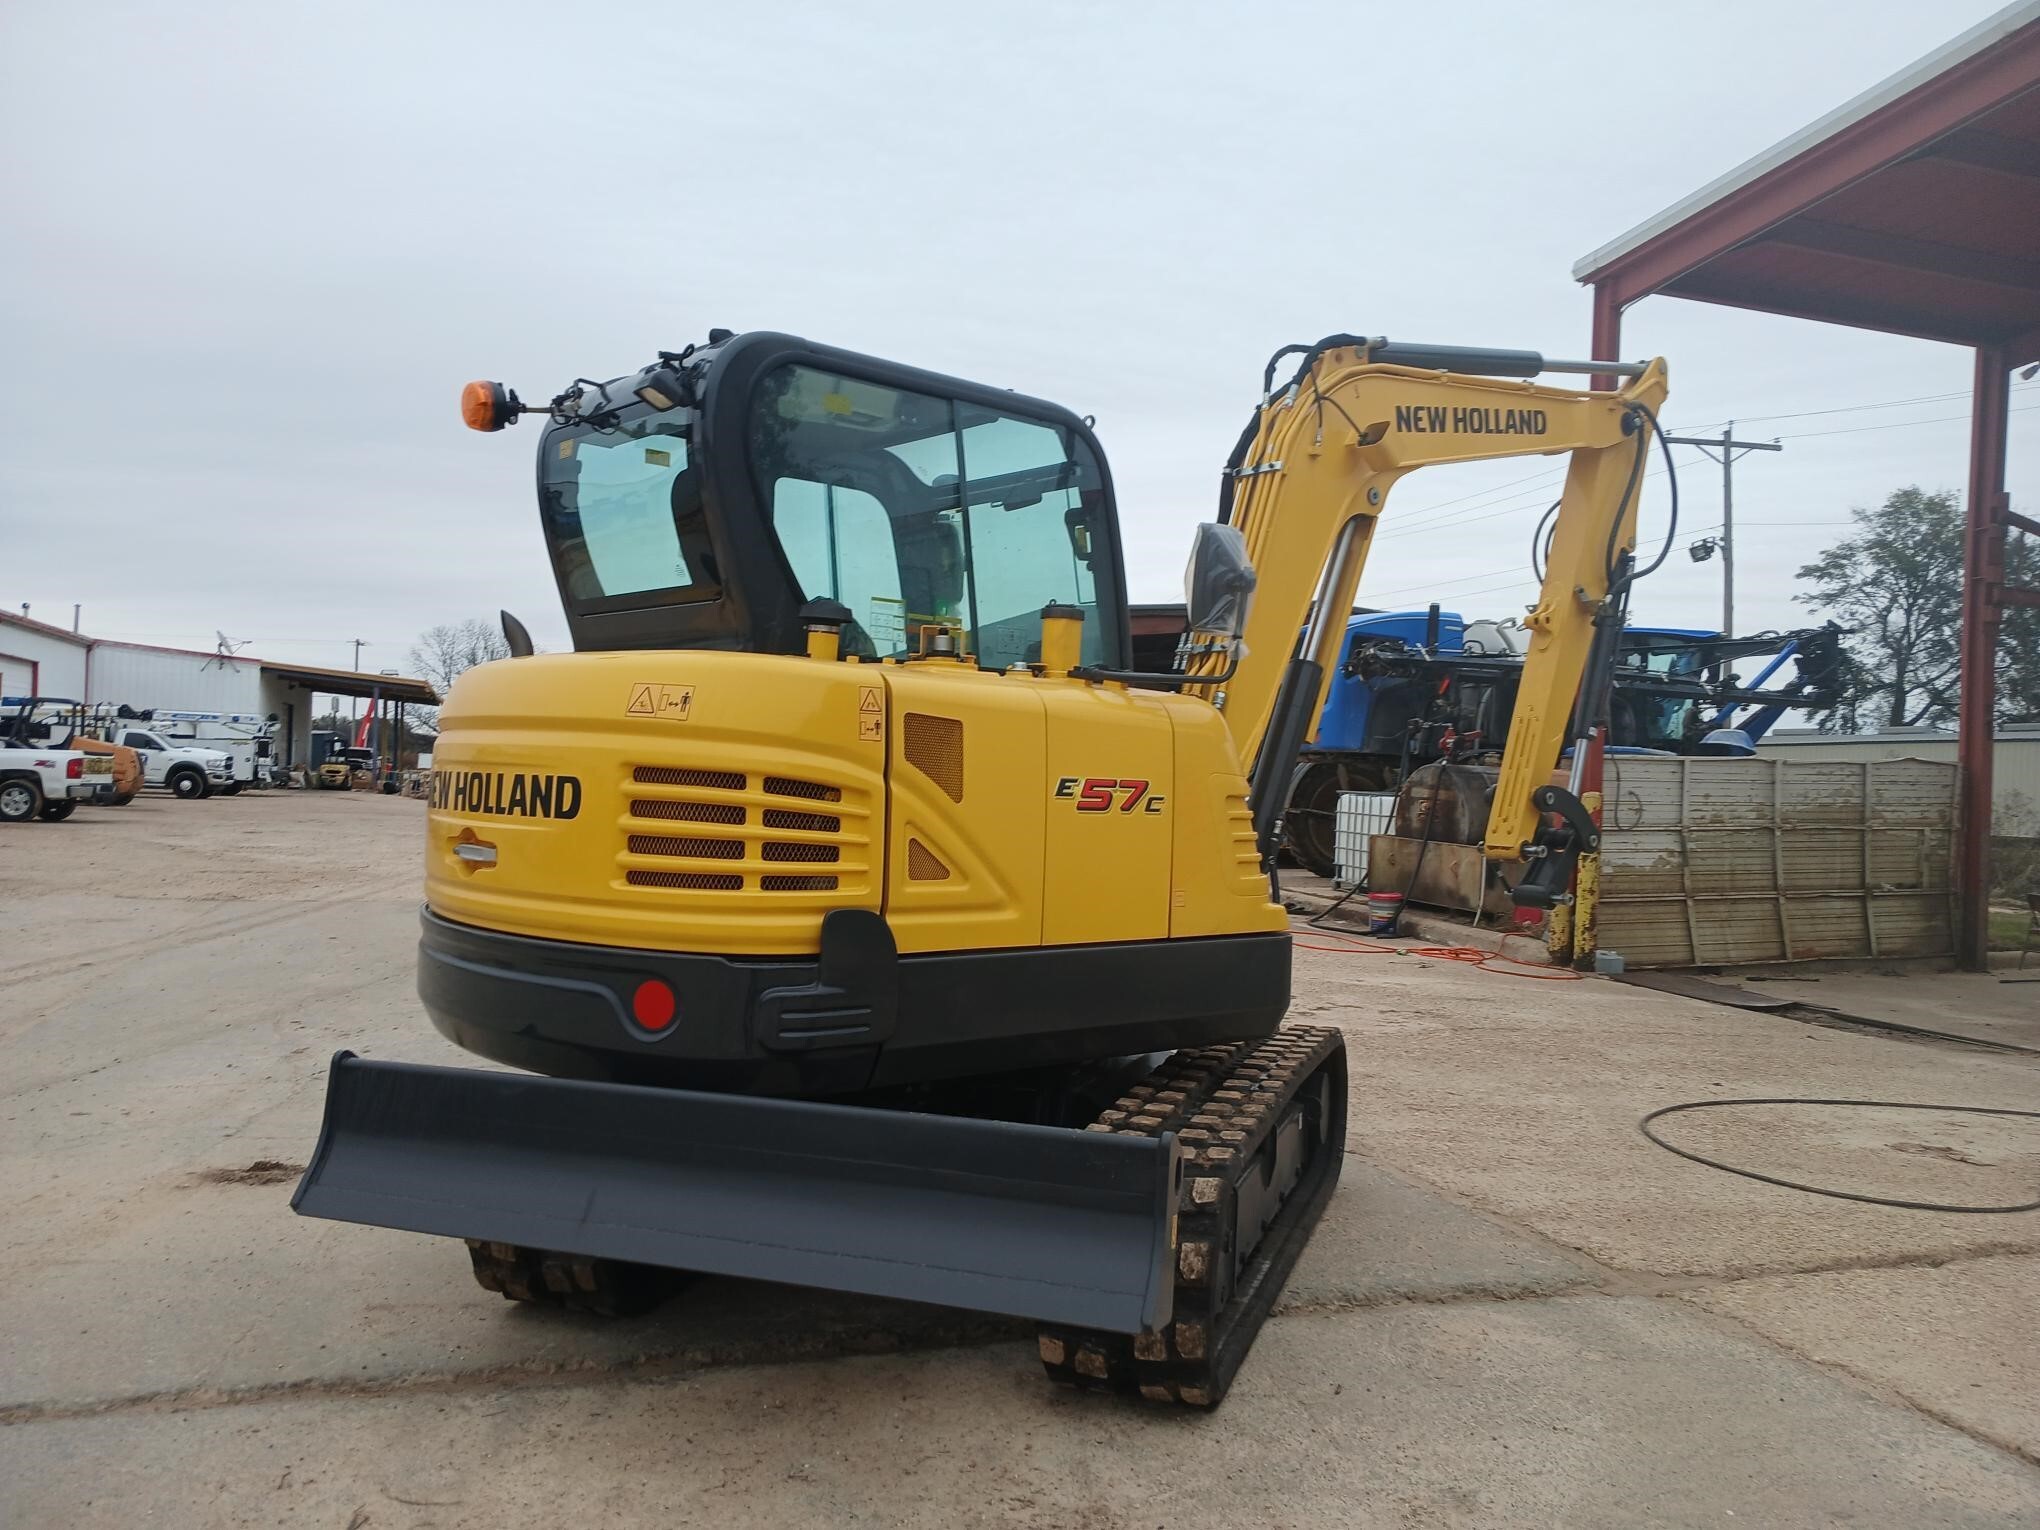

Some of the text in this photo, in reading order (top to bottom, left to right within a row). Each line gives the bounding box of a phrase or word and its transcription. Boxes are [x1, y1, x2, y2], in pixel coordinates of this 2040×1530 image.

[1395, 405, 1547, 435] NEW HOLLAND
[428, 770, 582, 820] EW HOLLAND
